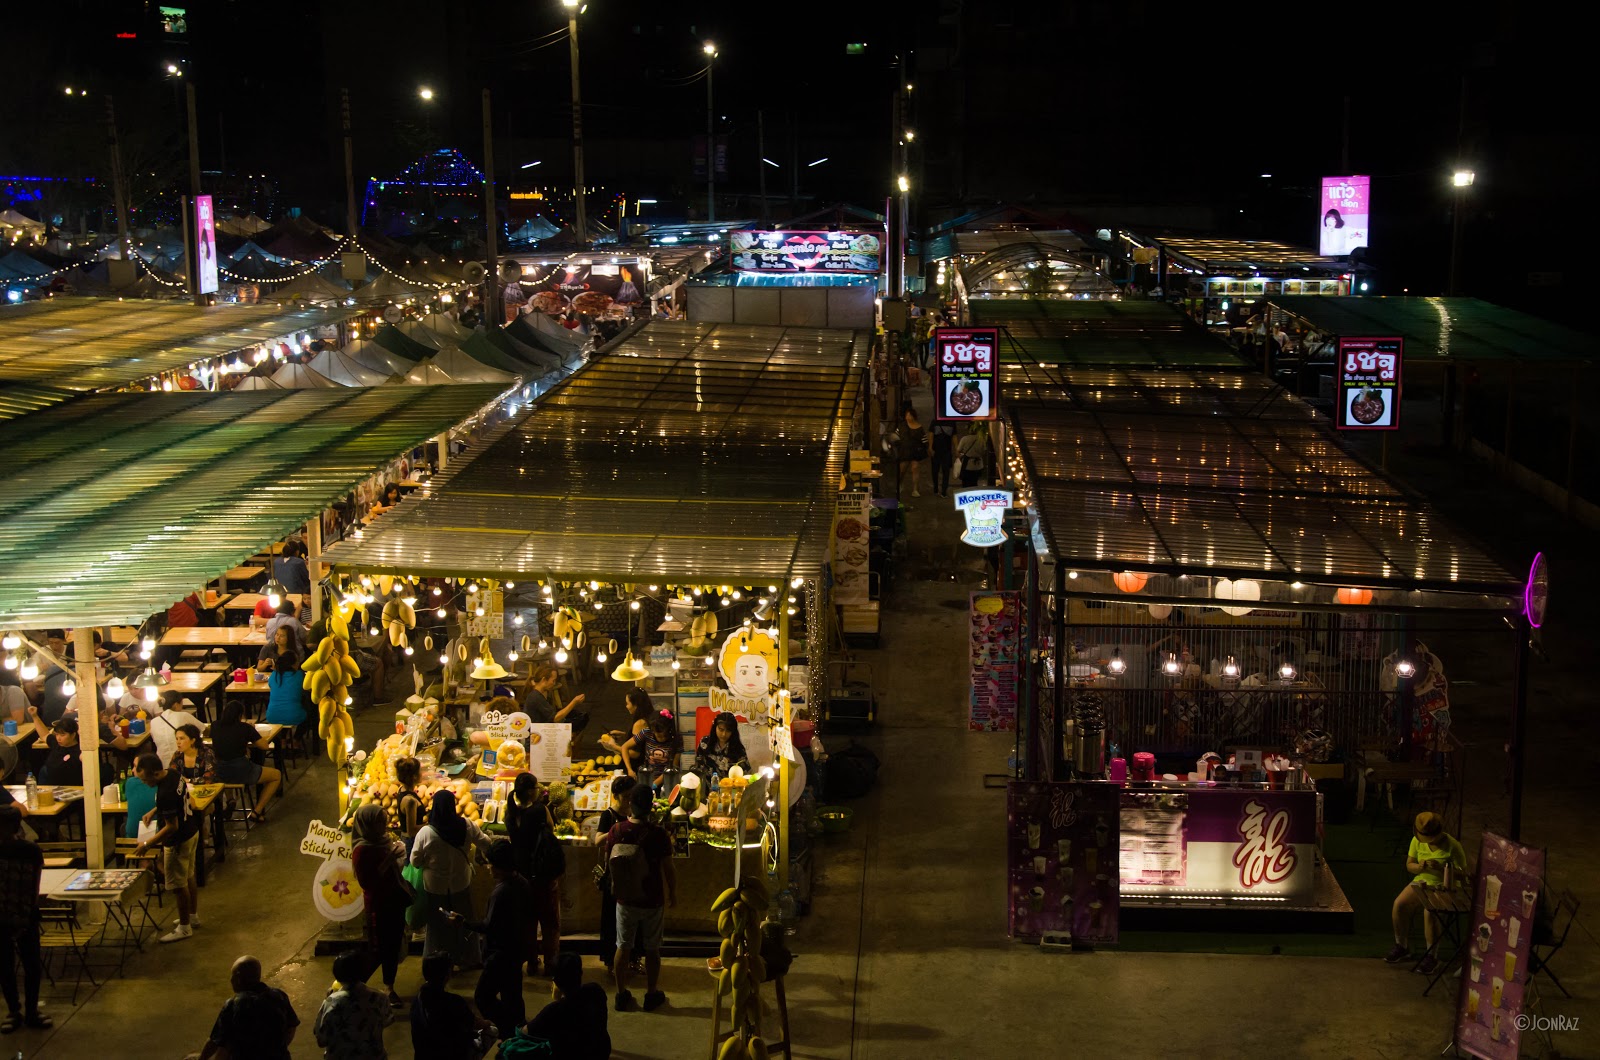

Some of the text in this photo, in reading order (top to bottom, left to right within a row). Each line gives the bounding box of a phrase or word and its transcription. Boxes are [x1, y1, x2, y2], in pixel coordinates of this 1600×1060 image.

[711, 689, 767, 721] Mango
[309, 823, 343, 843] Mango
[302, 840, 353, 861] Sticky Ric
